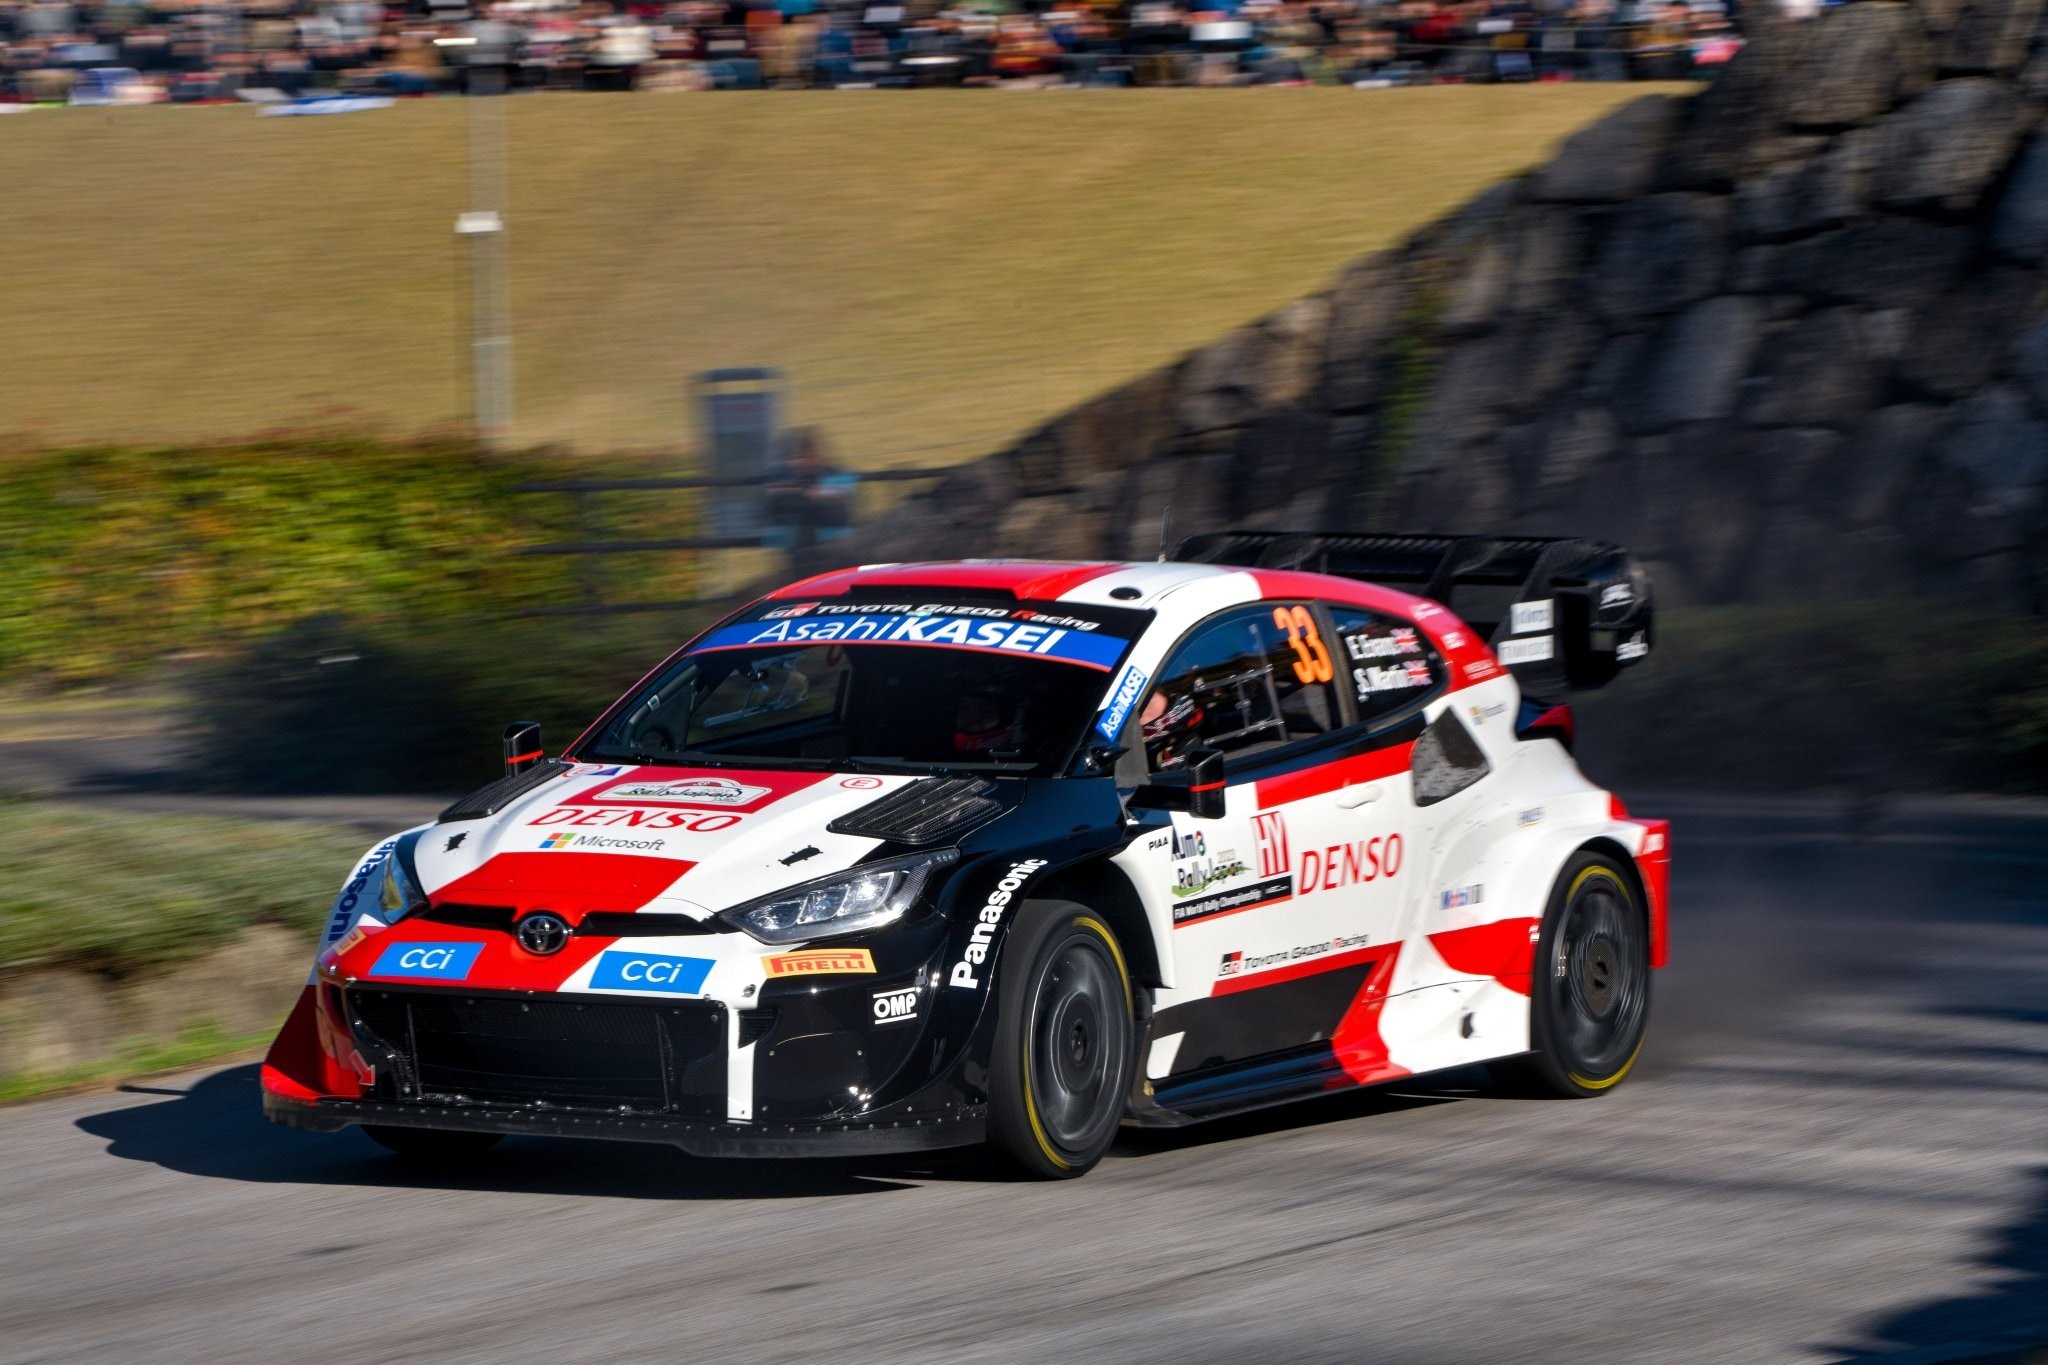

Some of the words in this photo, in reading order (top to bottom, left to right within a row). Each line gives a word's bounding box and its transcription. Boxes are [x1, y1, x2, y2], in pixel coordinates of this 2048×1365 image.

[817, 604, 910, 615] TOYOTA
[916, 604, 1009, 618] GAZOO
[1011, 609, 1102, 631] Racing
[748, 615, 1068, 655] AsahiKASEI
[1273, 605, 1334, 684] 33
[526, 808, 743, 832] DENSO
[574, 834, 667, 852] Microsoft
[1148, 836, 1168, 851] PIAA
[1299, 833, 1404, 896] DENSO
[328, 841, 396, 941] anasoni
[949, 858, 1048, 989] Panasonic
[399, 947, 453, 969] CCi
[769, 952, 867, 974] PIRELLI
[1244, 951, 1289, 970] TOYOTA
[1332, 934, 1369, 949] Racing
[620, 959, 683, 983] CCi
[873, 990, 916, 1019] OMP
